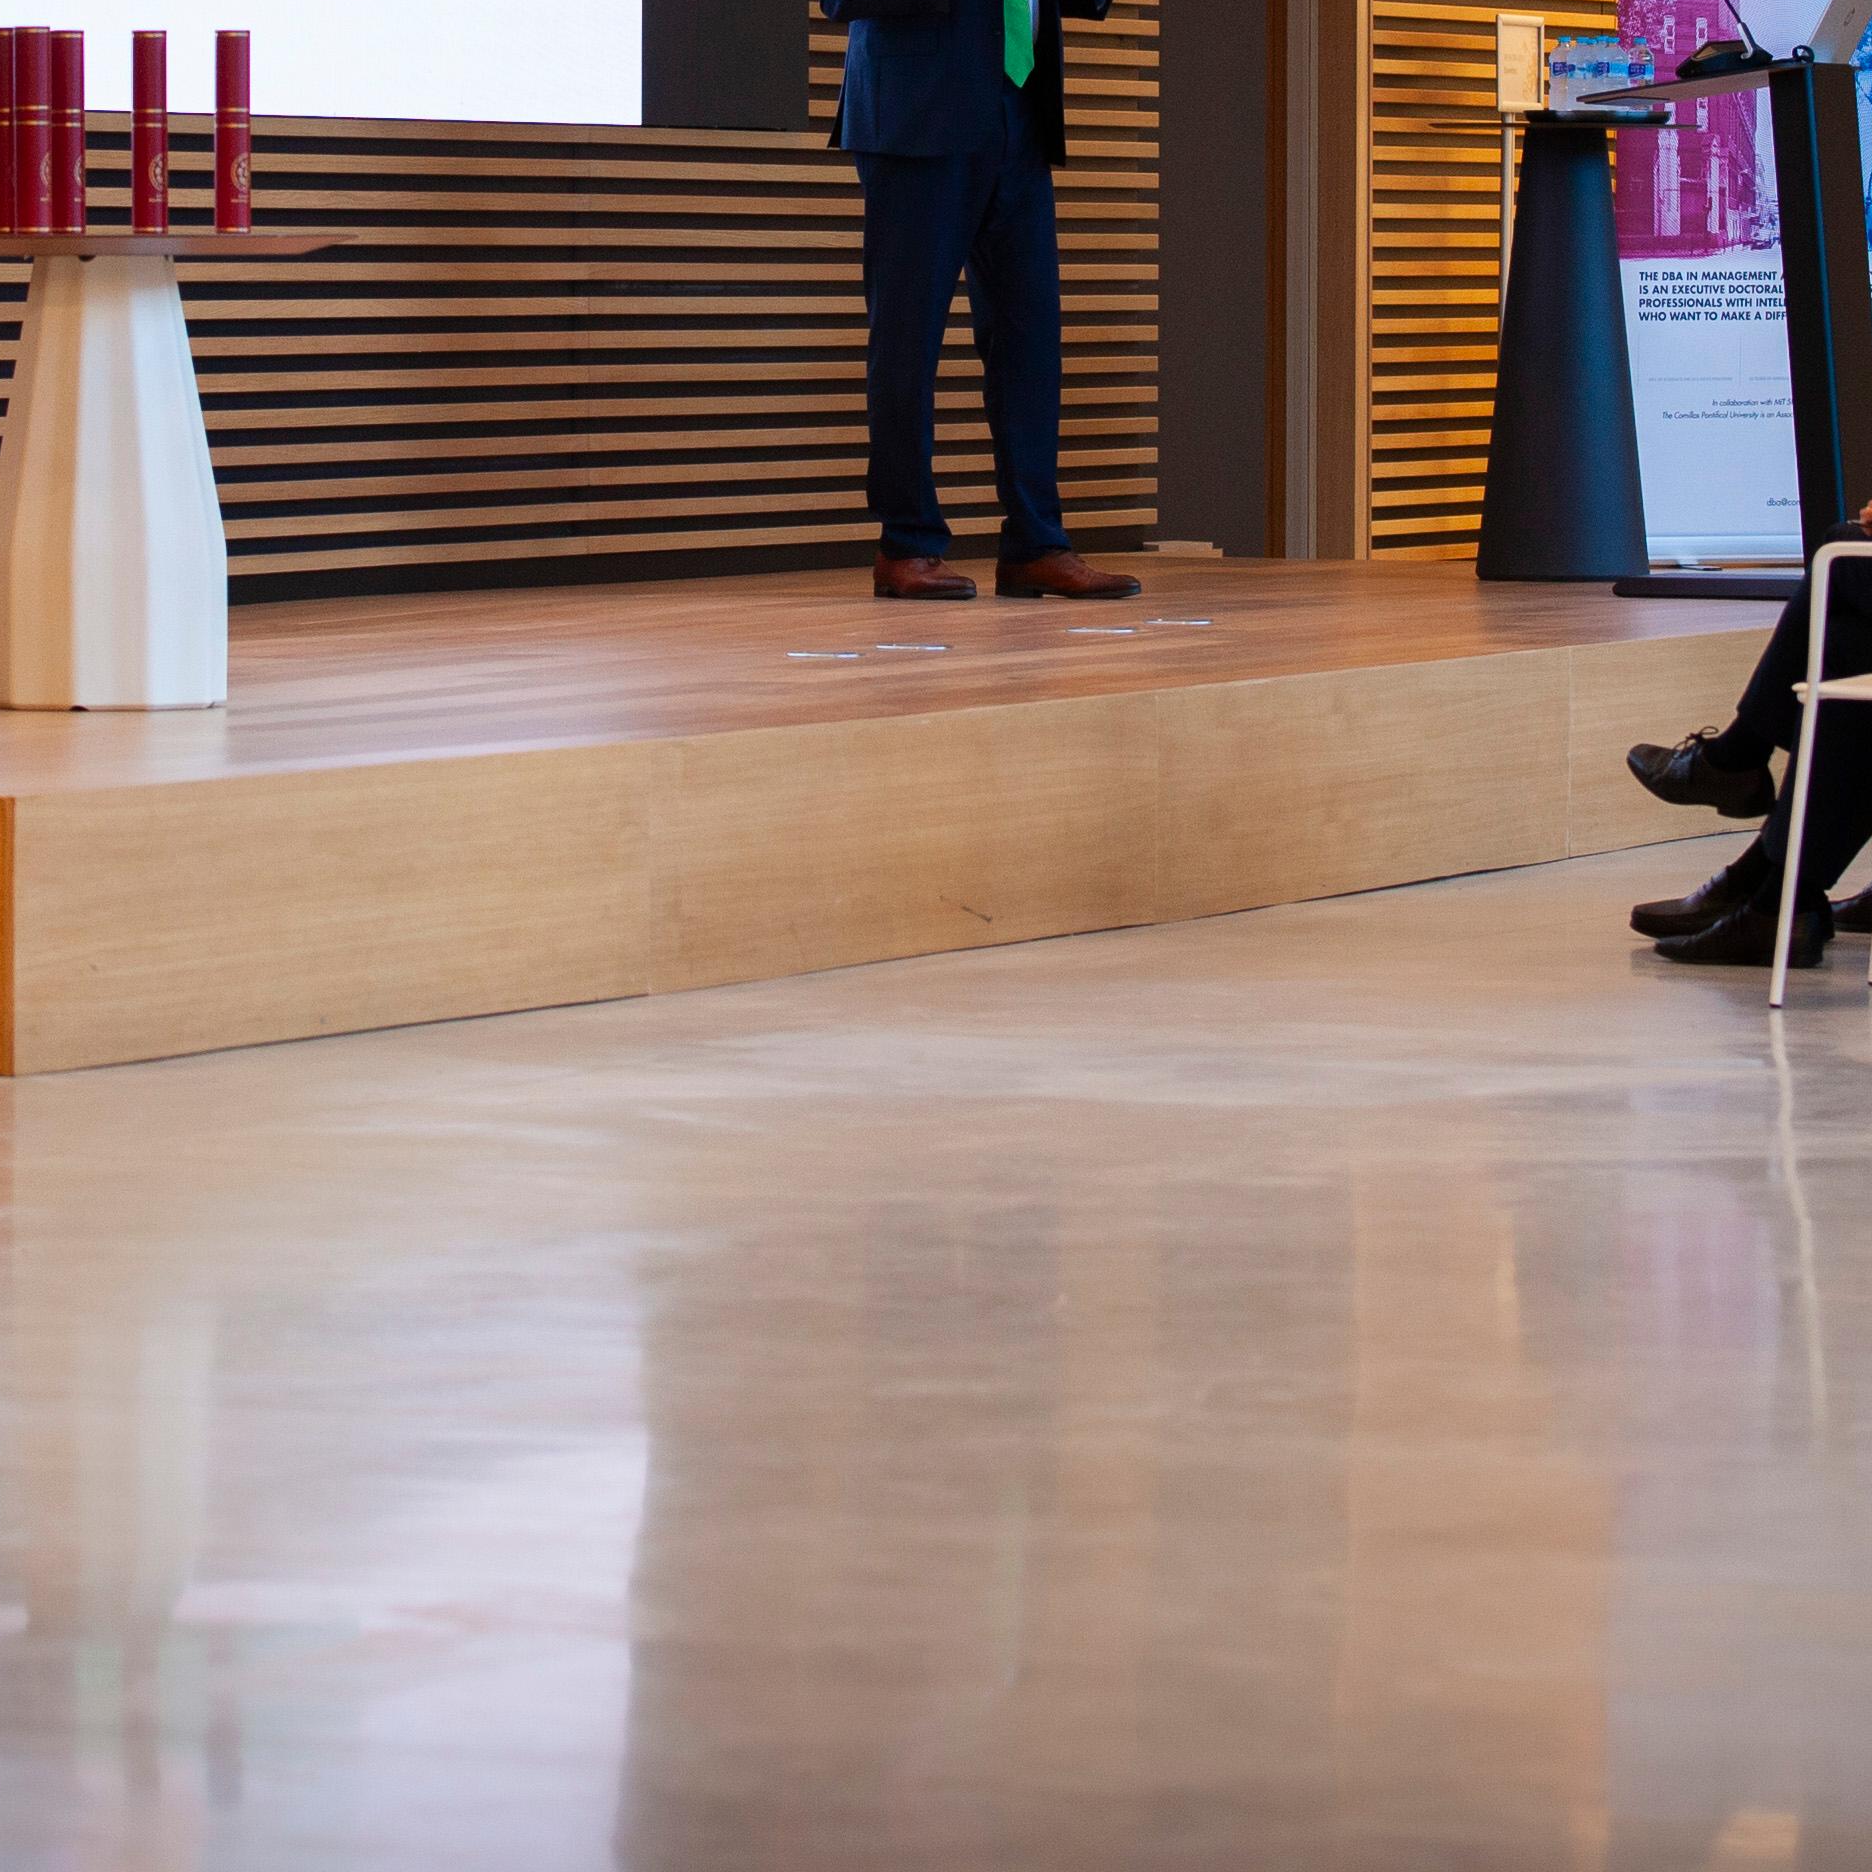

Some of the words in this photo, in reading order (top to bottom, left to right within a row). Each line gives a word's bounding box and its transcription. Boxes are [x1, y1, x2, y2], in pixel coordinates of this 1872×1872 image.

[1638, 270, 1659, 281] THE
[1661, 270, 1684, 281] DBA
[1685, 270, 1698, 281] IN
[1700, 270, 1778, 281] MANAGEMENT
[1638, 284, 1649, 295] IS
[1651, 284, 1669, 295] AN
[1671, 283, 1725, 295] EXECUTIVE
[1728, 284, 1784, 294] DOCTORAL
[1638, 297, 1723, 308] PROFESSIONALS
[1724, 297, 1753, 308] WITH
[1637, 310, 1667, 322] WHO
[1668, 310, 1702, 321] WANT
[1703, 310, 1718, 321] TO
[1720, 310, 1751, 321] MAKE
[1753, 310, 1762, 321] A
